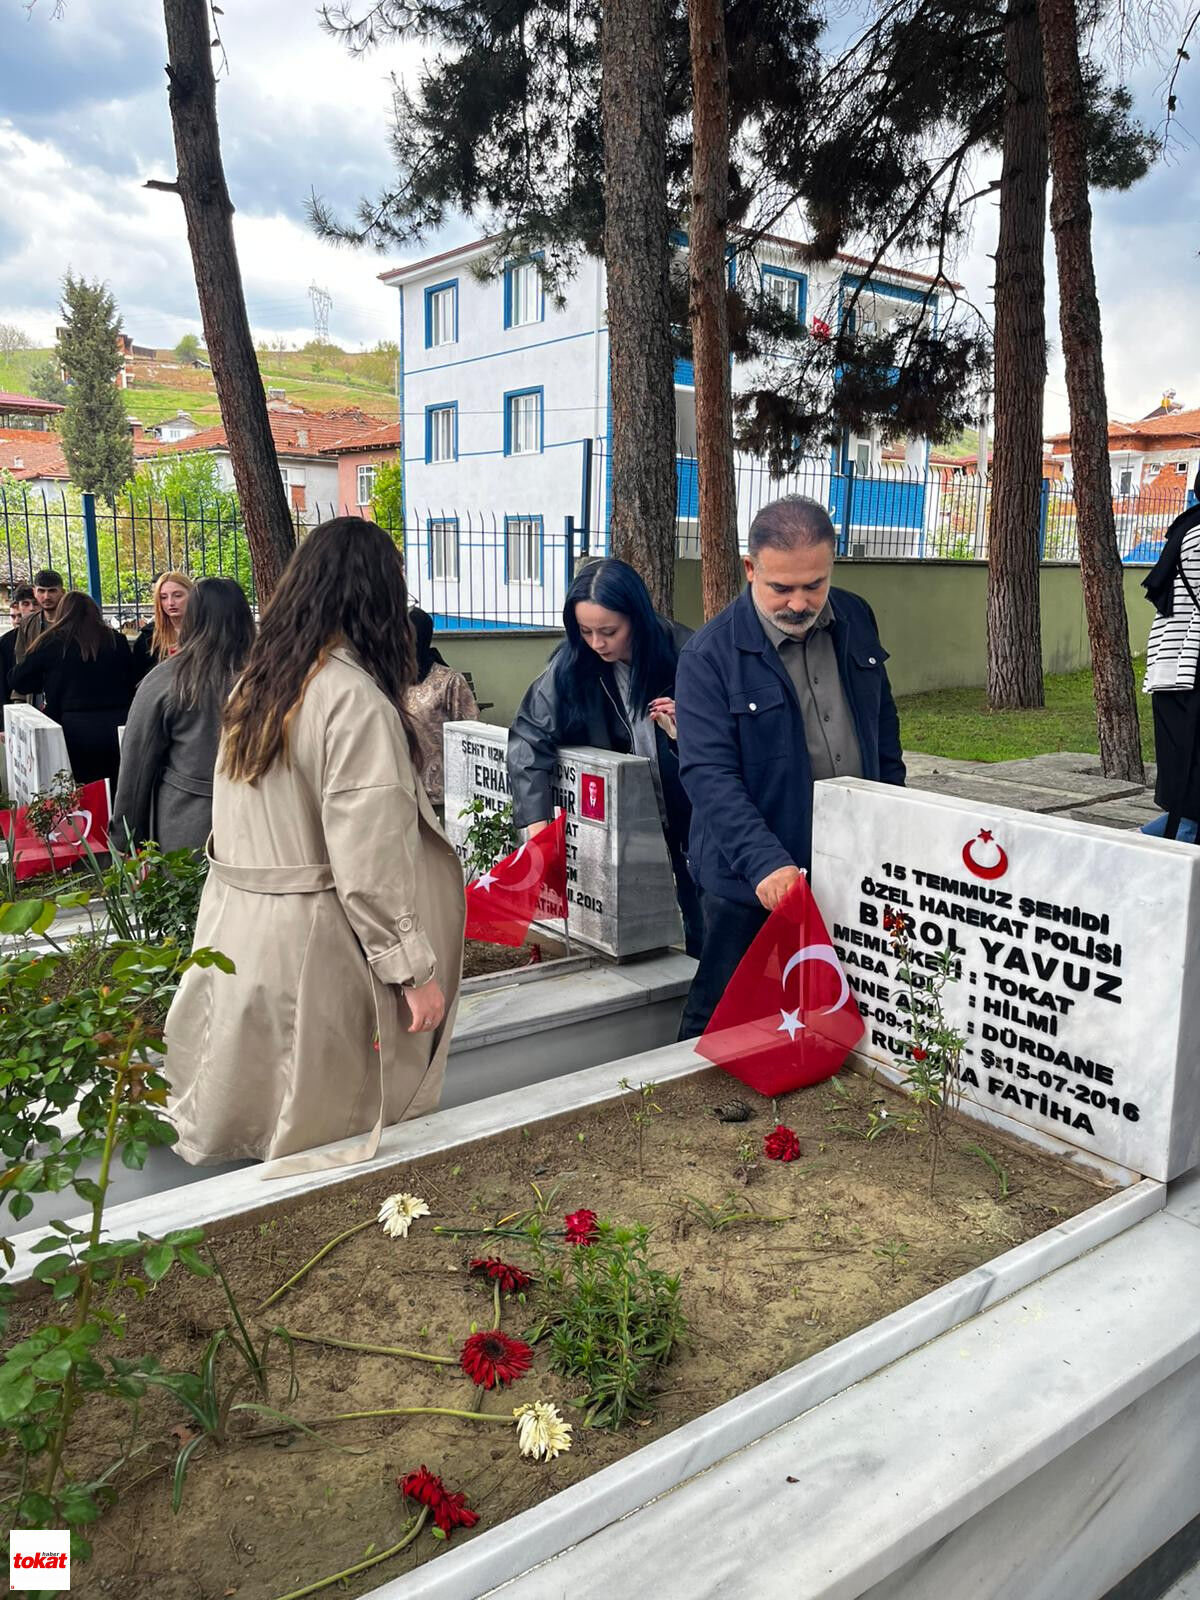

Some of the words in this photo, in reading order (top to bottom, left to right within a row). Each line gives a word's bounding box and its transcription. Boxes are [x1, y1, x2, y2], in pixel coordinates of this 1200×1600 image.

[475, 764, 513, 795] ERHAN
[535, 897, 564, 918] ATİHA
[860, 875, 914, 908] ÖZEL
[919, 894, 1029, 939] HAREKAT
[1034, 926, 1123, 967] POLİSİ
[881, 862, 907, 881] 15
[912, 868, 1013, 910] TEMMUZ
[1018, 896, 1110, 936] ŞEHİDİ
[833, 923, 963, 981] MEMLKEİ
[983, 972, 1076, 1016] TOKAT
[833, 945, 890, 978] BABA
[983, 996, 1058, 1037] HİLMİ
[979, 936, 1124, 1004] YAVUZ
[846, 973, 890, 1004] NNE
[982, 1022, 1115, 1086] DÜRDANE
[988, 1077, 1096, 1136] FATİHA
